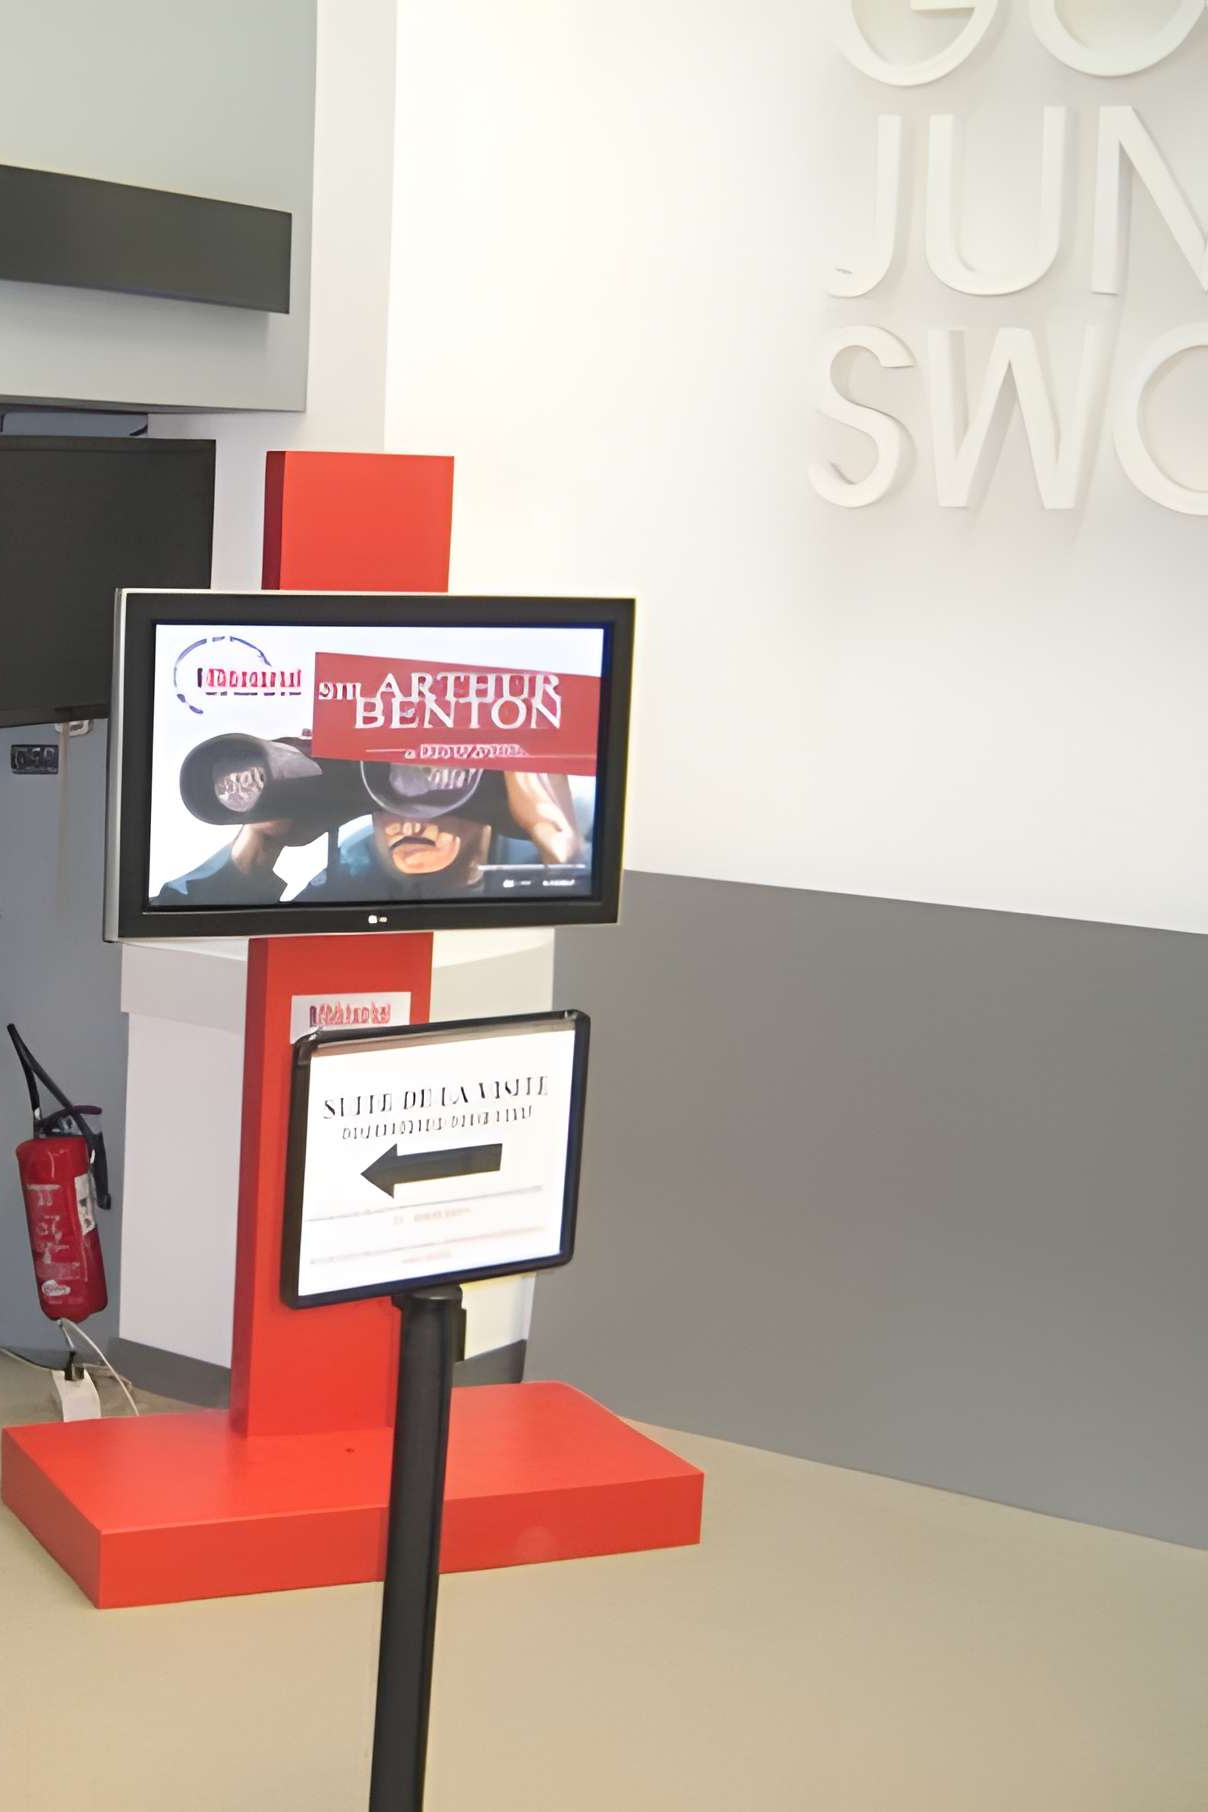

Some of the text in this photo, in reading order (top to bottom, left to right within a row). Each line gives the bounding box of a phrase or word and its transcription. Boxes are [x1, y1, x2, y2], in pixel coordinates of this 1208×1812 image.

[822, 104, 1208, 298] JUN
[376, 671, 561, 702] ARTHUR
[354, 697, 561, 730] BENTON
